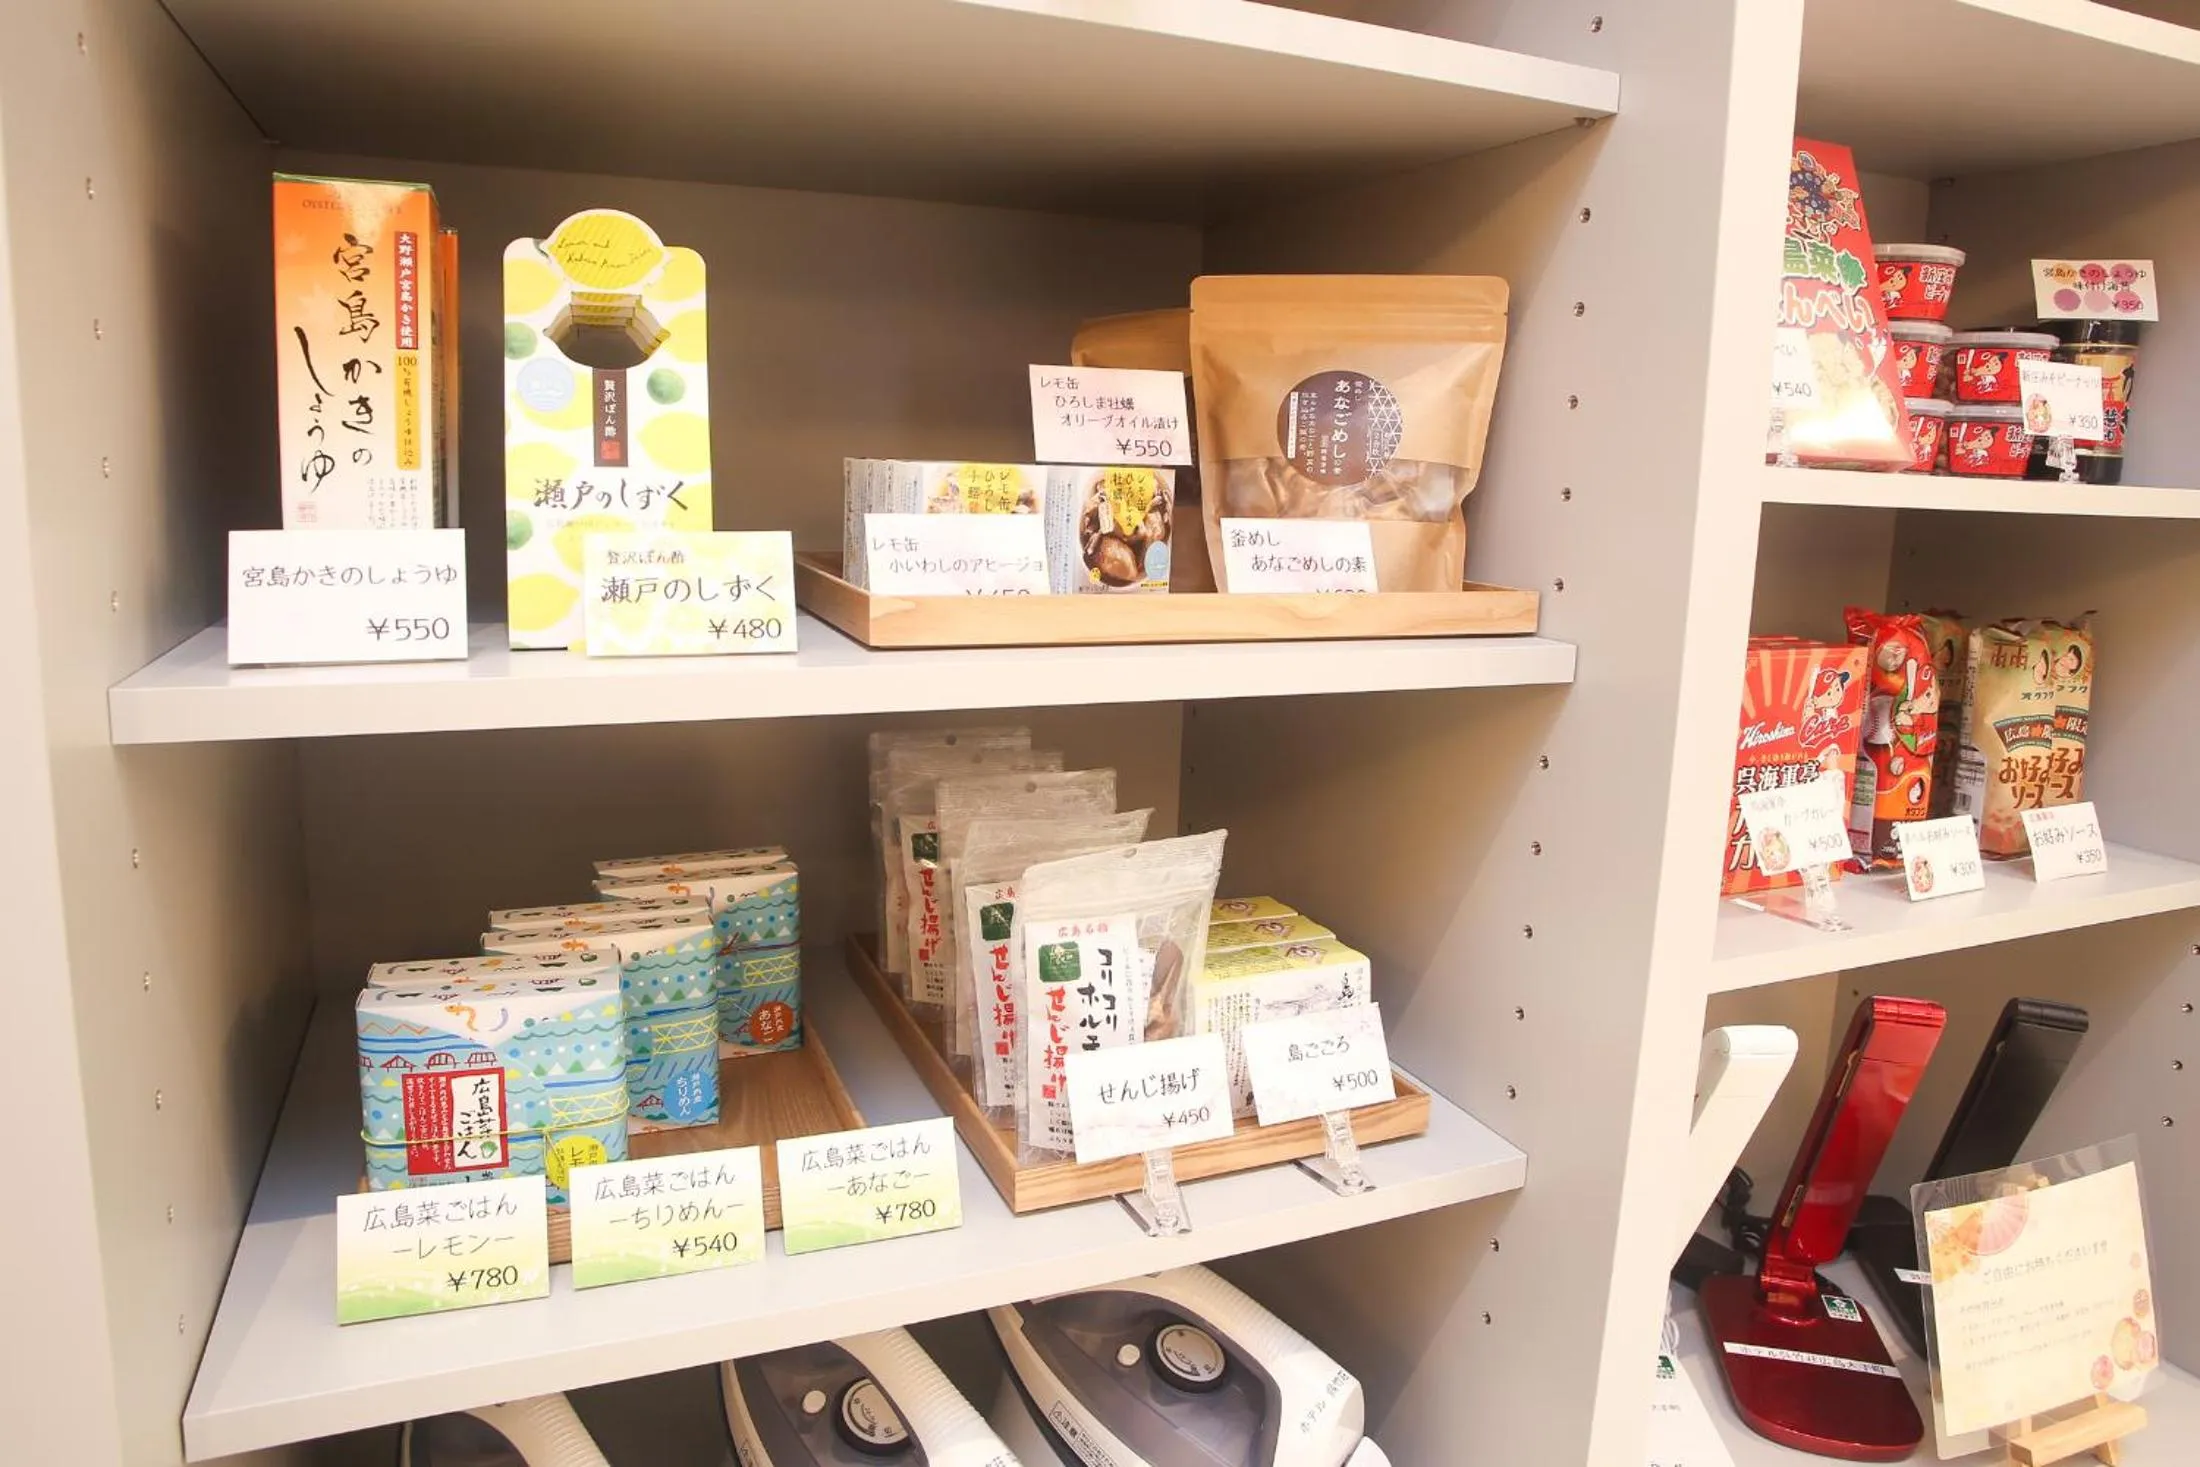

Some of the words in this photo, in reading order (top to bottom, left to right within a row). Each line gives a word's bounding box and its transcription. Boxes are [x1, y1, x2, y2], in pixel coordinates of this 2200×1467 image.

[1040, 375, 1080, 391] レモ缶
[1115, 437, 1174, 458] ¥550
[533, 477, 689, 512] 瀬戸のしずく
[872, 536, 921, 552] レモ缶
[1231, 528, 1280, 548] 釜めし
[242, 564, 458, 588] 宮島かきのしょうゆ
[889, 556, 1045, 574] 小いわしのアヒージョ
[1251, 555, 1369, 573] あなごめしの素
[600, 574, 777, 604] 瀬戸のしずく
[365, 616, 450, 642] ¥550
[708, 617, 783, 640] ¥480
[1287, 1035, 1350, 1063] 島ごころ
[1099, 1067, 1201, 1105] せんじ揚げ
[1332, 1068, 1379, 1092] ¥500
[1162, 1106, 1211, 1129] ¥450
[801, 1132, 932, 1173] 広島菜ごはん
[594, 1163, 737, 1202] 広島菜ごはん
[362, 1193, 519, 1233] 広島菜ごはん
[874, 1199, 937, 1225] ¥780
[671, 1231, 738, 1259] ¥540
[447, 1264, 519, 1293] ¥780
